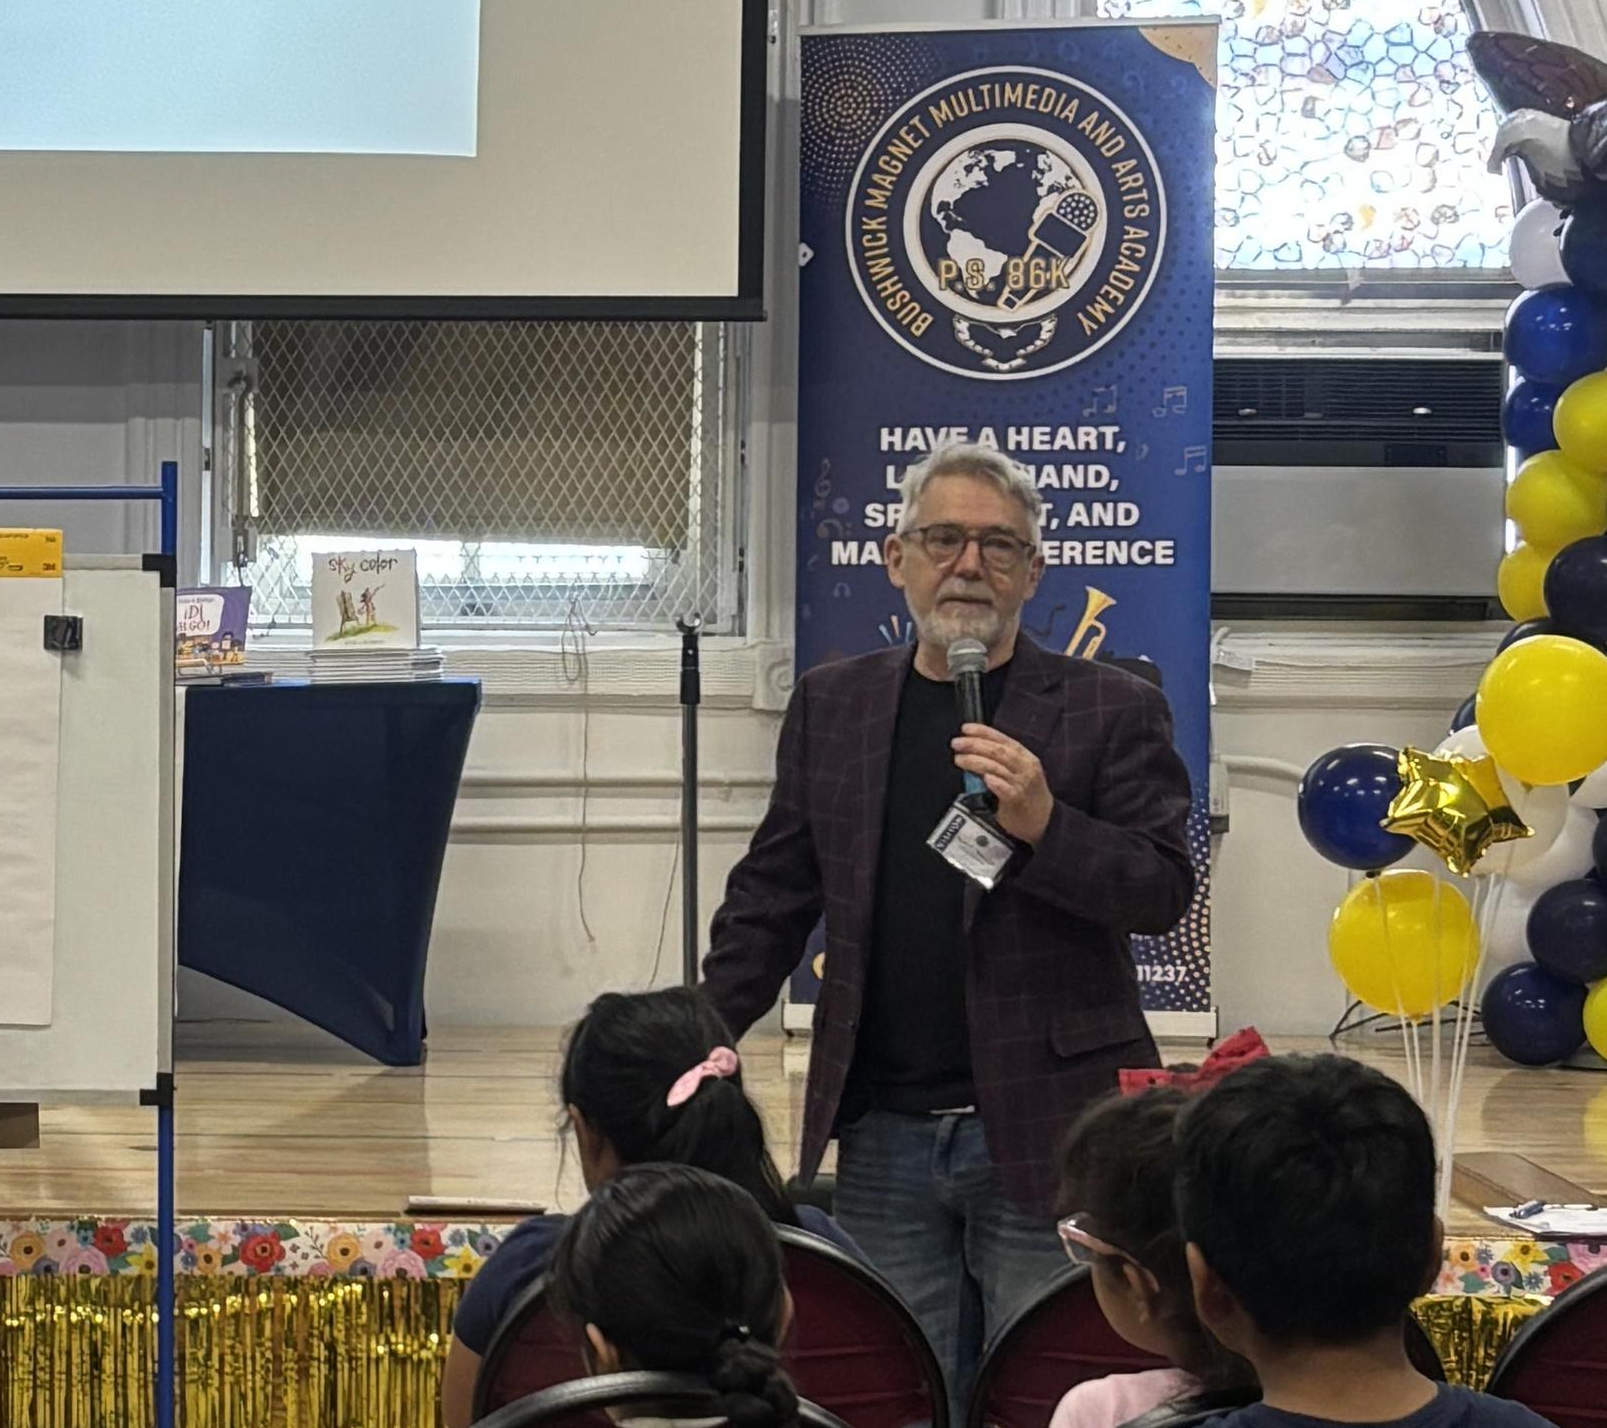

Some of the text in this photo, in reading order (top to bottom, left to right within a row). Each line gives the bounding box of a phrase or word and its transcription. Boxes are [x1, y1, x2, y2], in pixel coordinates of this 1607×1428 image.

[861, 82, 1150, 338] BUSHWICK MAGNET MULTIMEDIA AND ARTS ACADEMY
[938, 258, 1070, 291] P.S. 86K
[880, 426, 1127, 453] HAVE A HEART,
[1066, 501, 1140, 527] AND
[360, 551, 398, 575] color
[831, 540, 1176, 565] MA ERENCE
